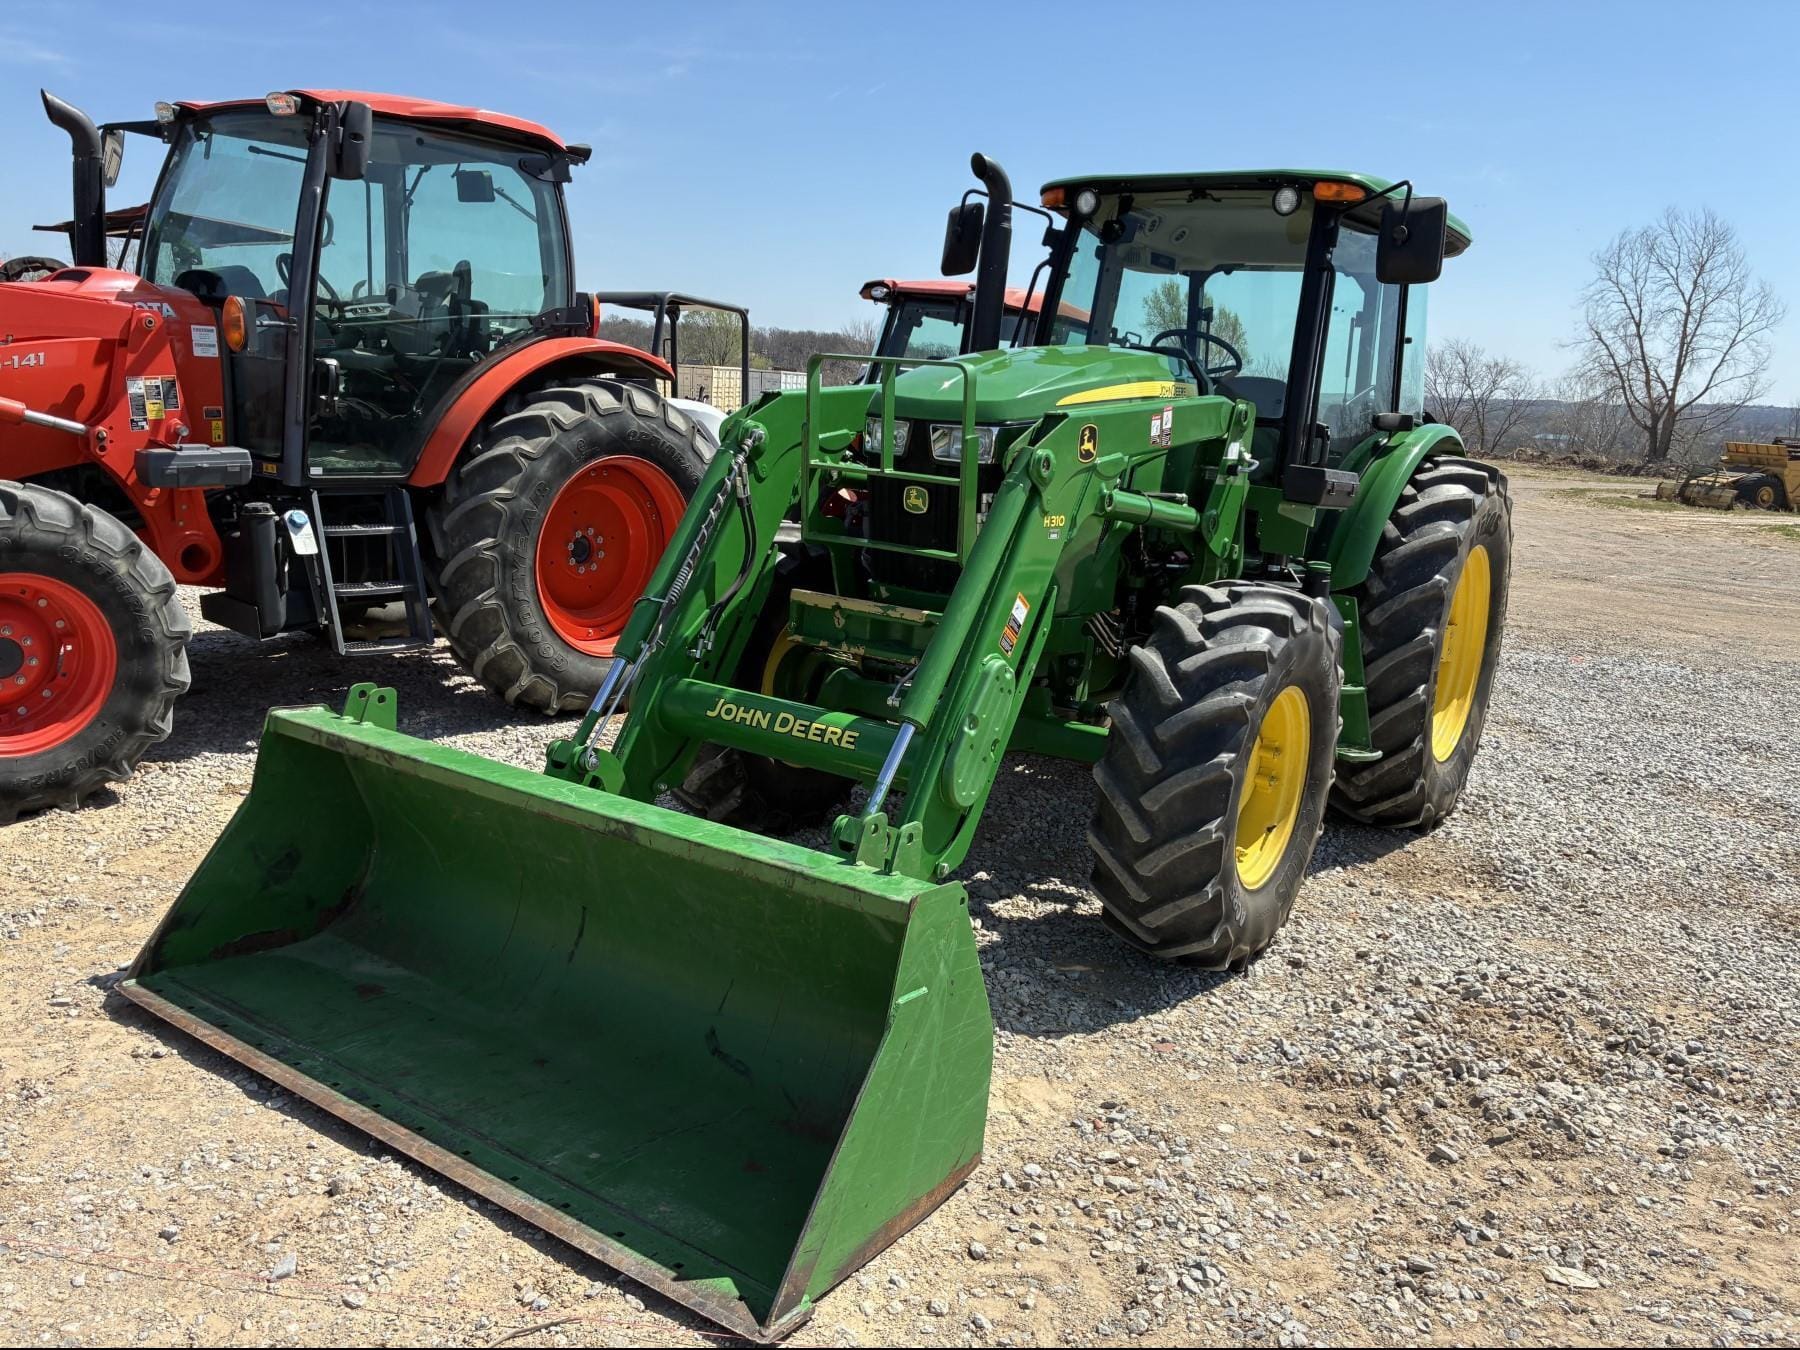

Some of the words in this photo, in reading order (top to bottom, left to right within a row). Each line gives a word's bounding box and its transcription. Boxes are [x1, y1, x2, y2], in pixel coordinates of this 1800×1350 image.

[1043, 515, 1065, 528] H310
[511, 481, 569, 672] GOODYEAR
[706, 698, 772, 730] JOHN
[773, 711, 860, 750] DEERE
